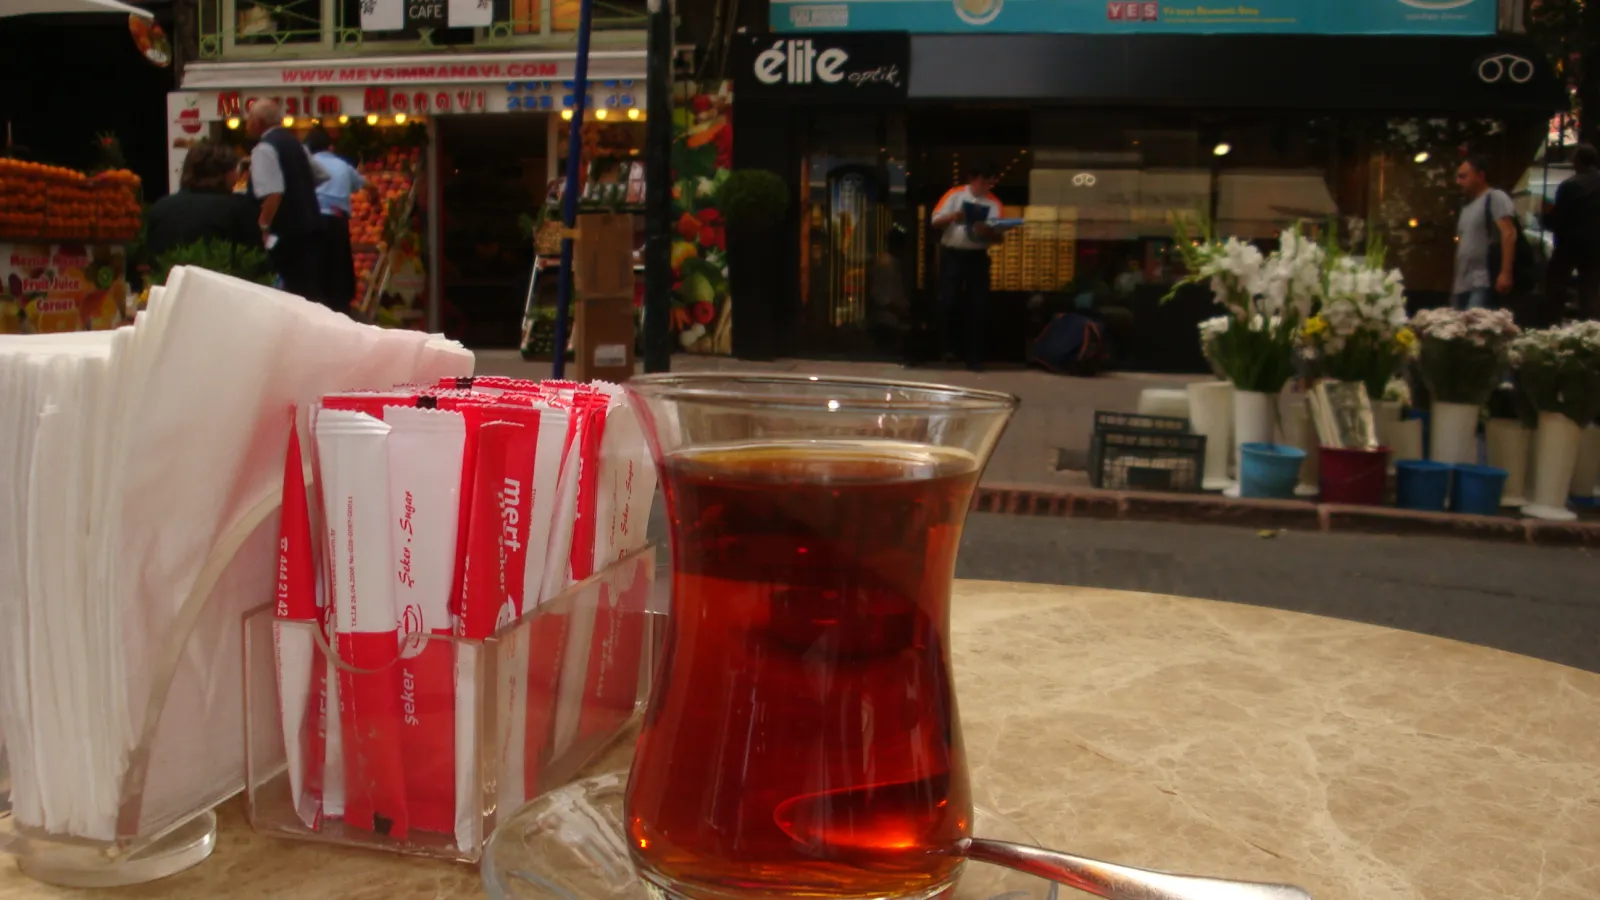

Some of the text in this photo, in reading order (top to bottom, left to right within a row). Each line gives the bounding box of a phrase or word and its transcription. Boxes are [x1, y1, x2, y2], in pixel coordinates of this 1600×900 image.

[409, 4, 442, 19] CAFE
[1109, 3, 1156, 17] YES
[754, 40, 848, 84] élite
[22, 276, 80, 291] Fruit Juice
[36, 298, 74, 312] Corner
[400, 490, 416, 536] Sugar
[504, 477, 521, 552] mert
[279, 555, 288, 580] 444
[401, 668, 419, 726] şeker
